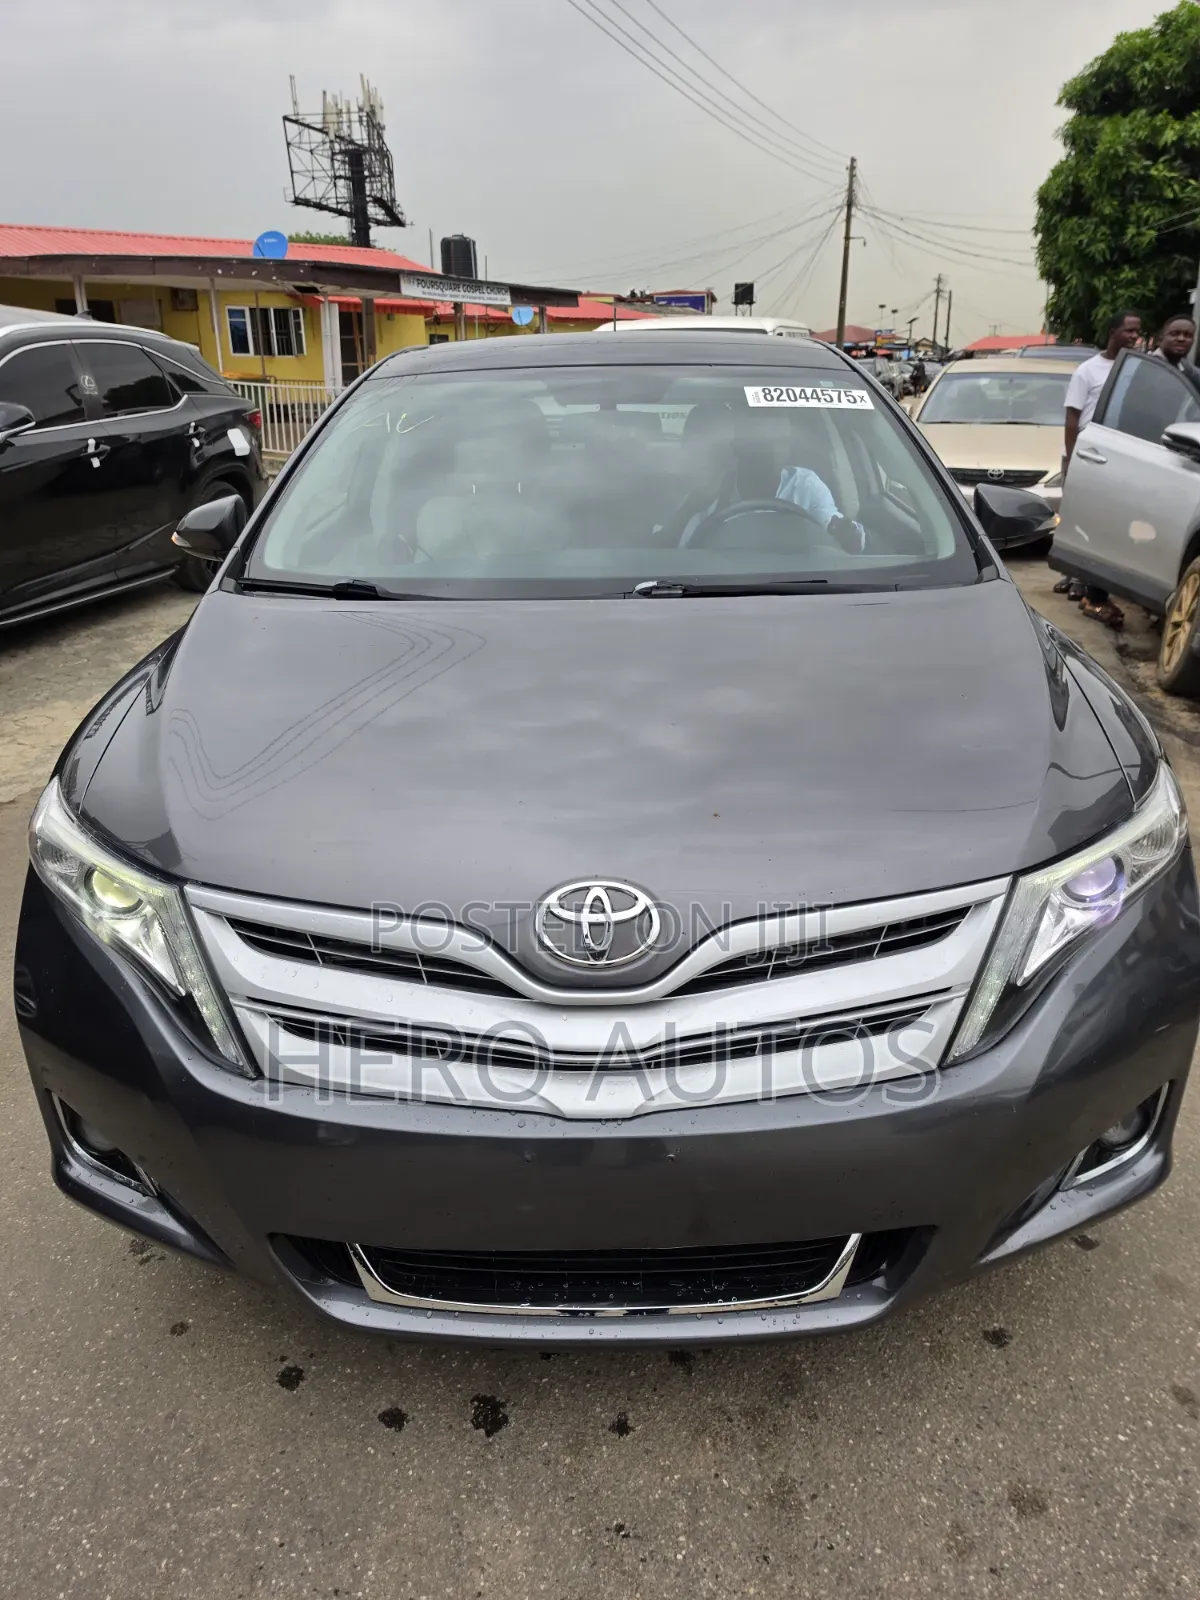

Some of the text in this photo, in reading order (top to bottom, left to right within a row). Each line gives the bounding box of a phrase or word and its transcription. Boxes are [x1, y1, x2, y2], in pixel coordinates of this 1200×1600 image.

[416, 278, 461, 292] FOURSQUARE
[462, 283, 485, 295] GOSPEL
[486, 286, 510, 297] CHURCH
